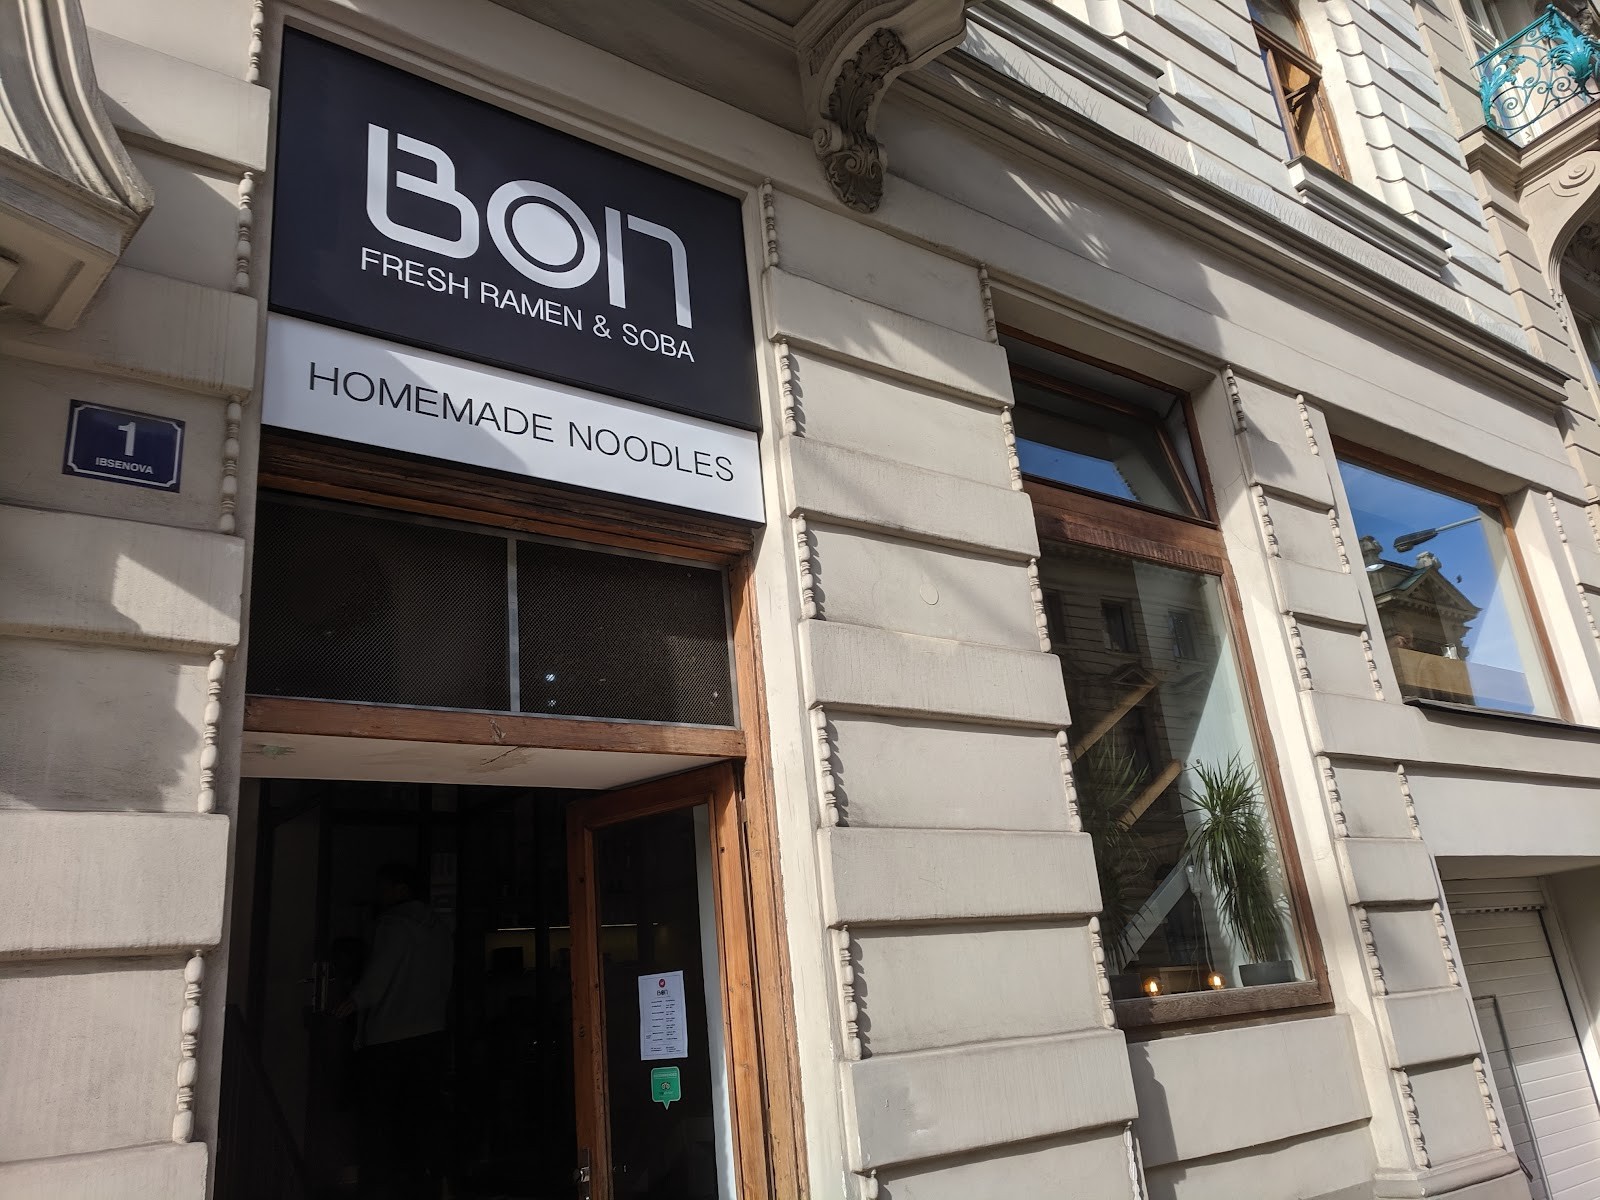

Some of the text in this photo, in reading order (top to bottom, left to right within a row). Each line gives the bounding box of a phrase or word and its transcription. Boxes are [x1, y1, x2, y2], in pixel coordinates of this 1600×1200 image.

[361, 247, 695, 363] FRESH RAMEN & SOBA
[118, 421, 136, 457] 1
[308, 361, 735, 483] HOMEMADE NOODLES
[95, 457, 154, 475] IBSENOVA
